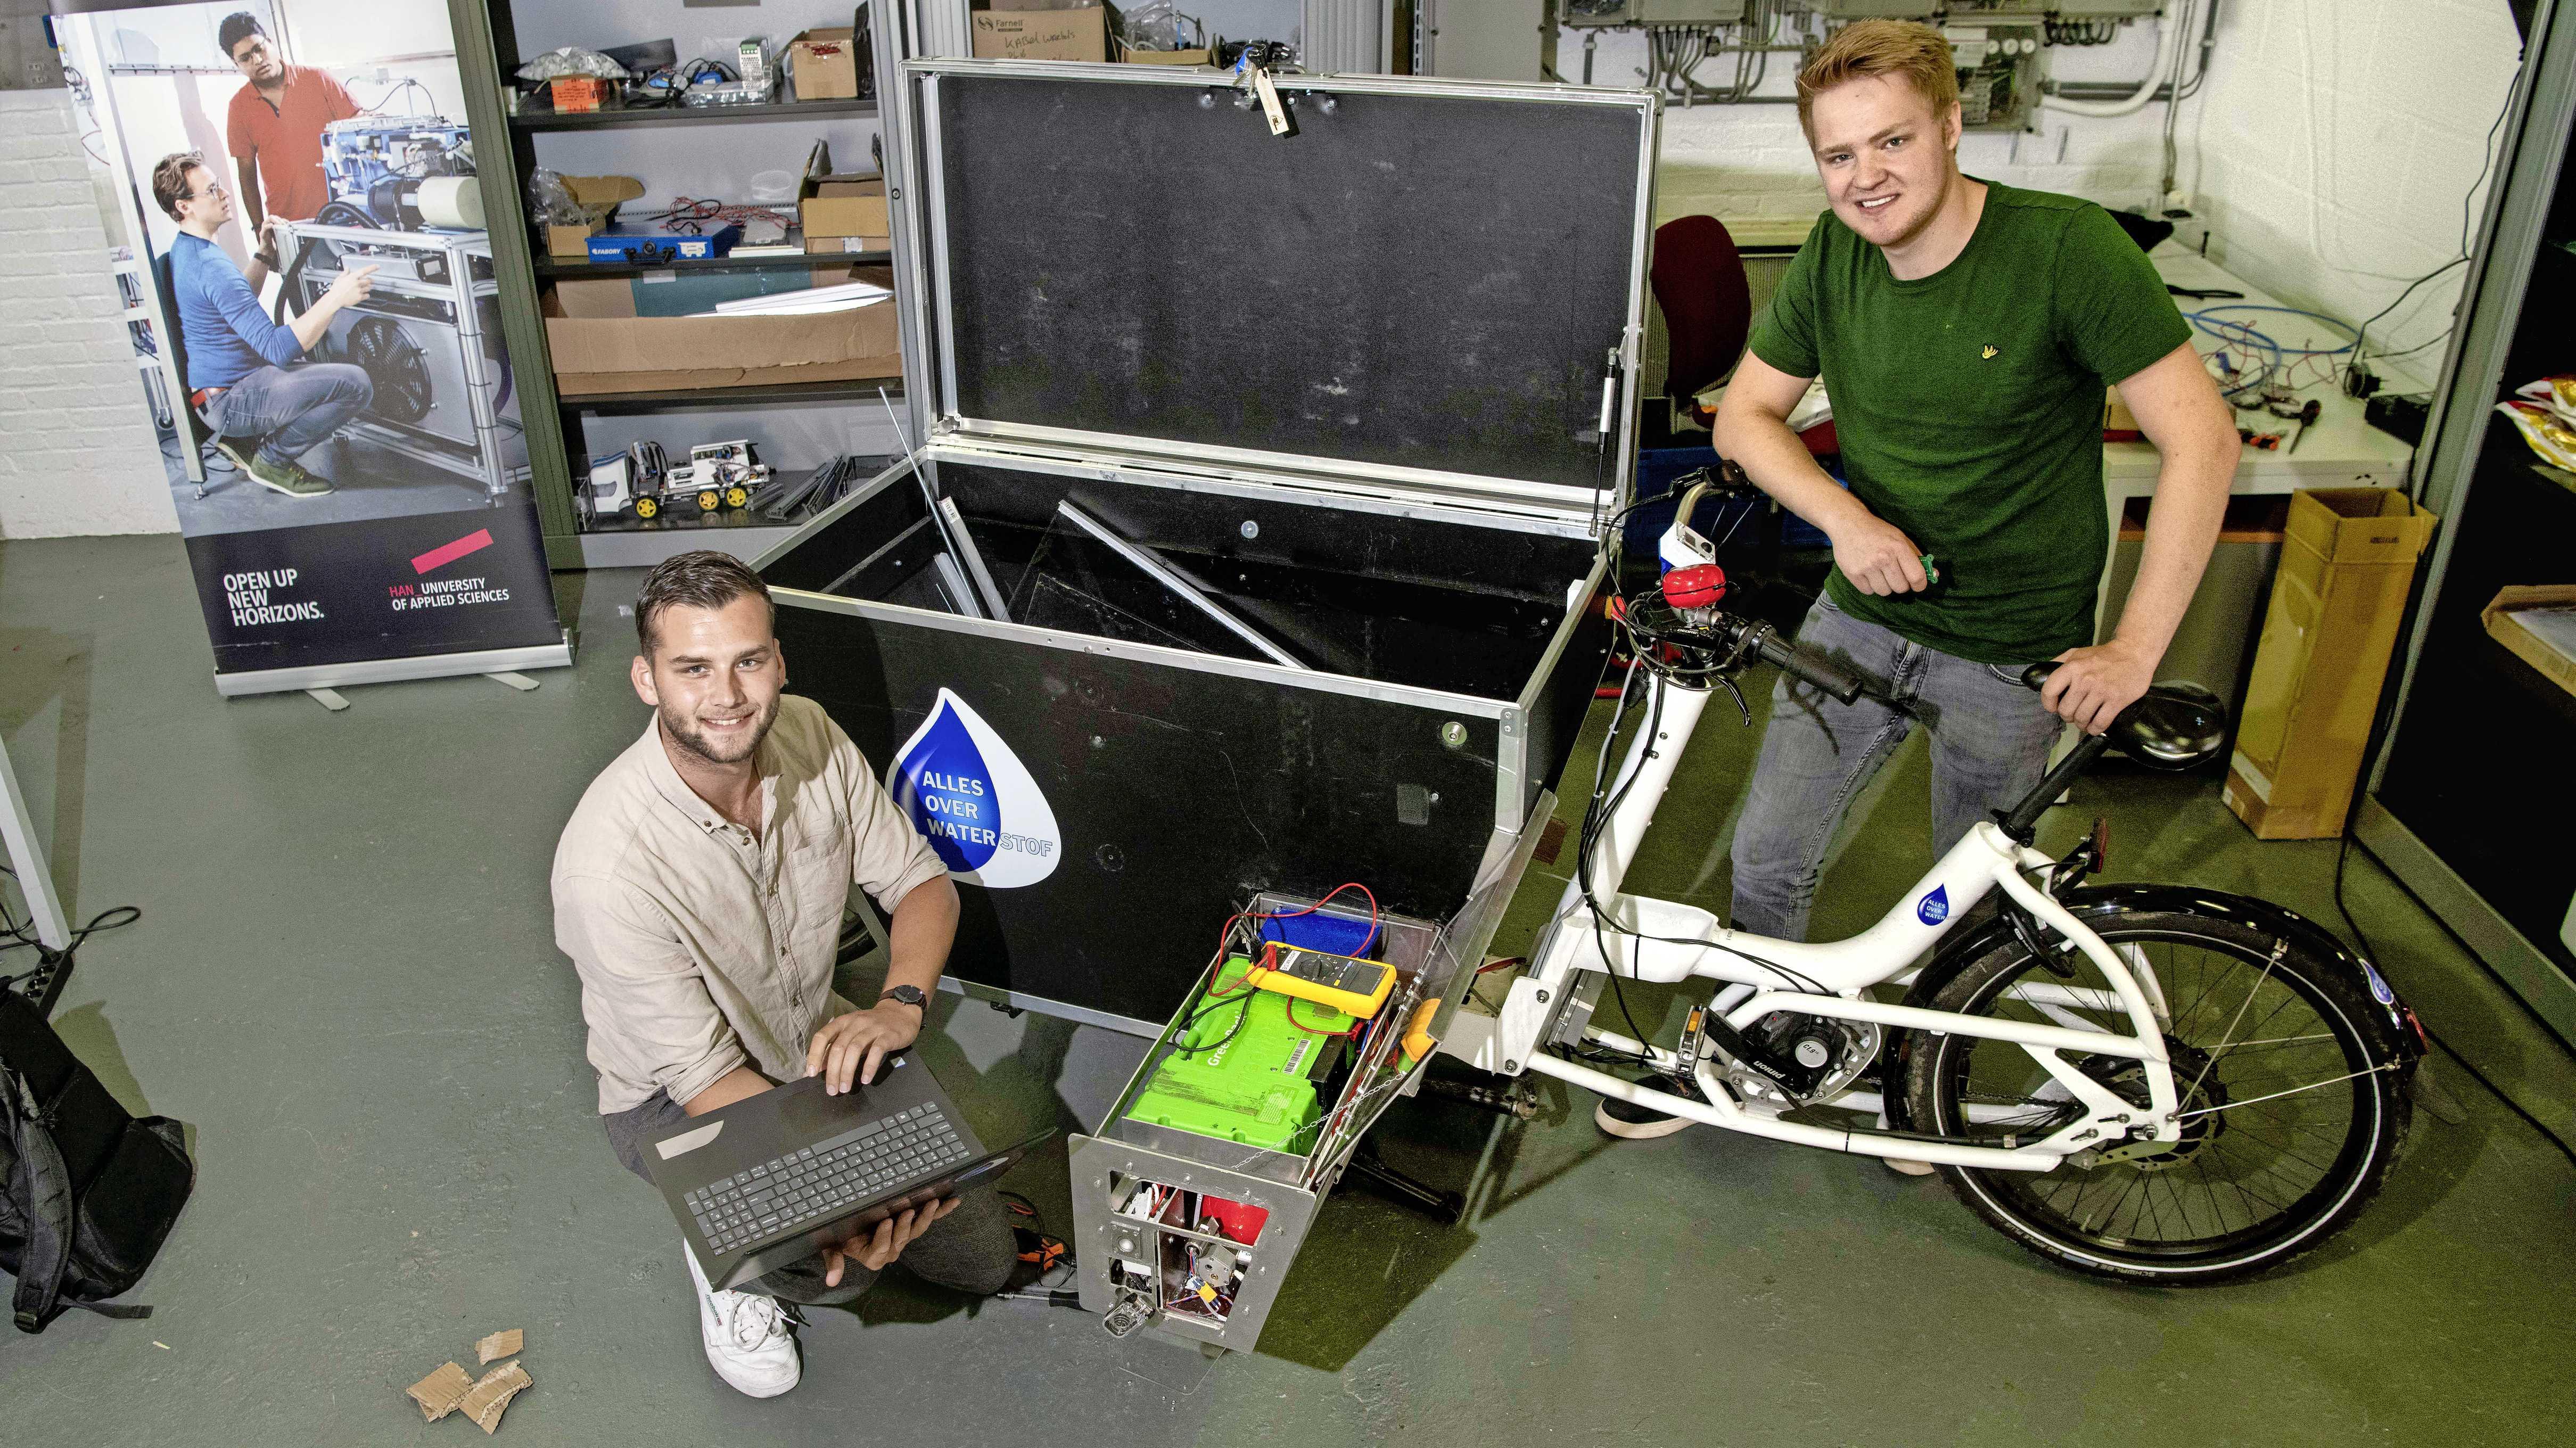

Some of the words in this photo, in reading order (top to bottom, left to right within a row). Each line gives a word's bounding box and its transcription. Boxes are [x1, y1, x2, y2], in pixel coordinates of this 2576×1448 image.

[224, 571, 271, 592] OPEN
[273, 568, 298, 587] UP
[227, 589, 268, 610] NEW
[392, 598, 407, 611] OF
[410, 595, 455, 610] APPLIED
[457, 589, 509, 605] SCIENCES
[232, 601, 325, 627] HORIZONS.
[923, 771, 984, 796] ALLES
[925, 795, 979, 820] OVER
[1928, 900, 1946, 909] ALLES
[706, 1295, 719, 1317] Reebok
